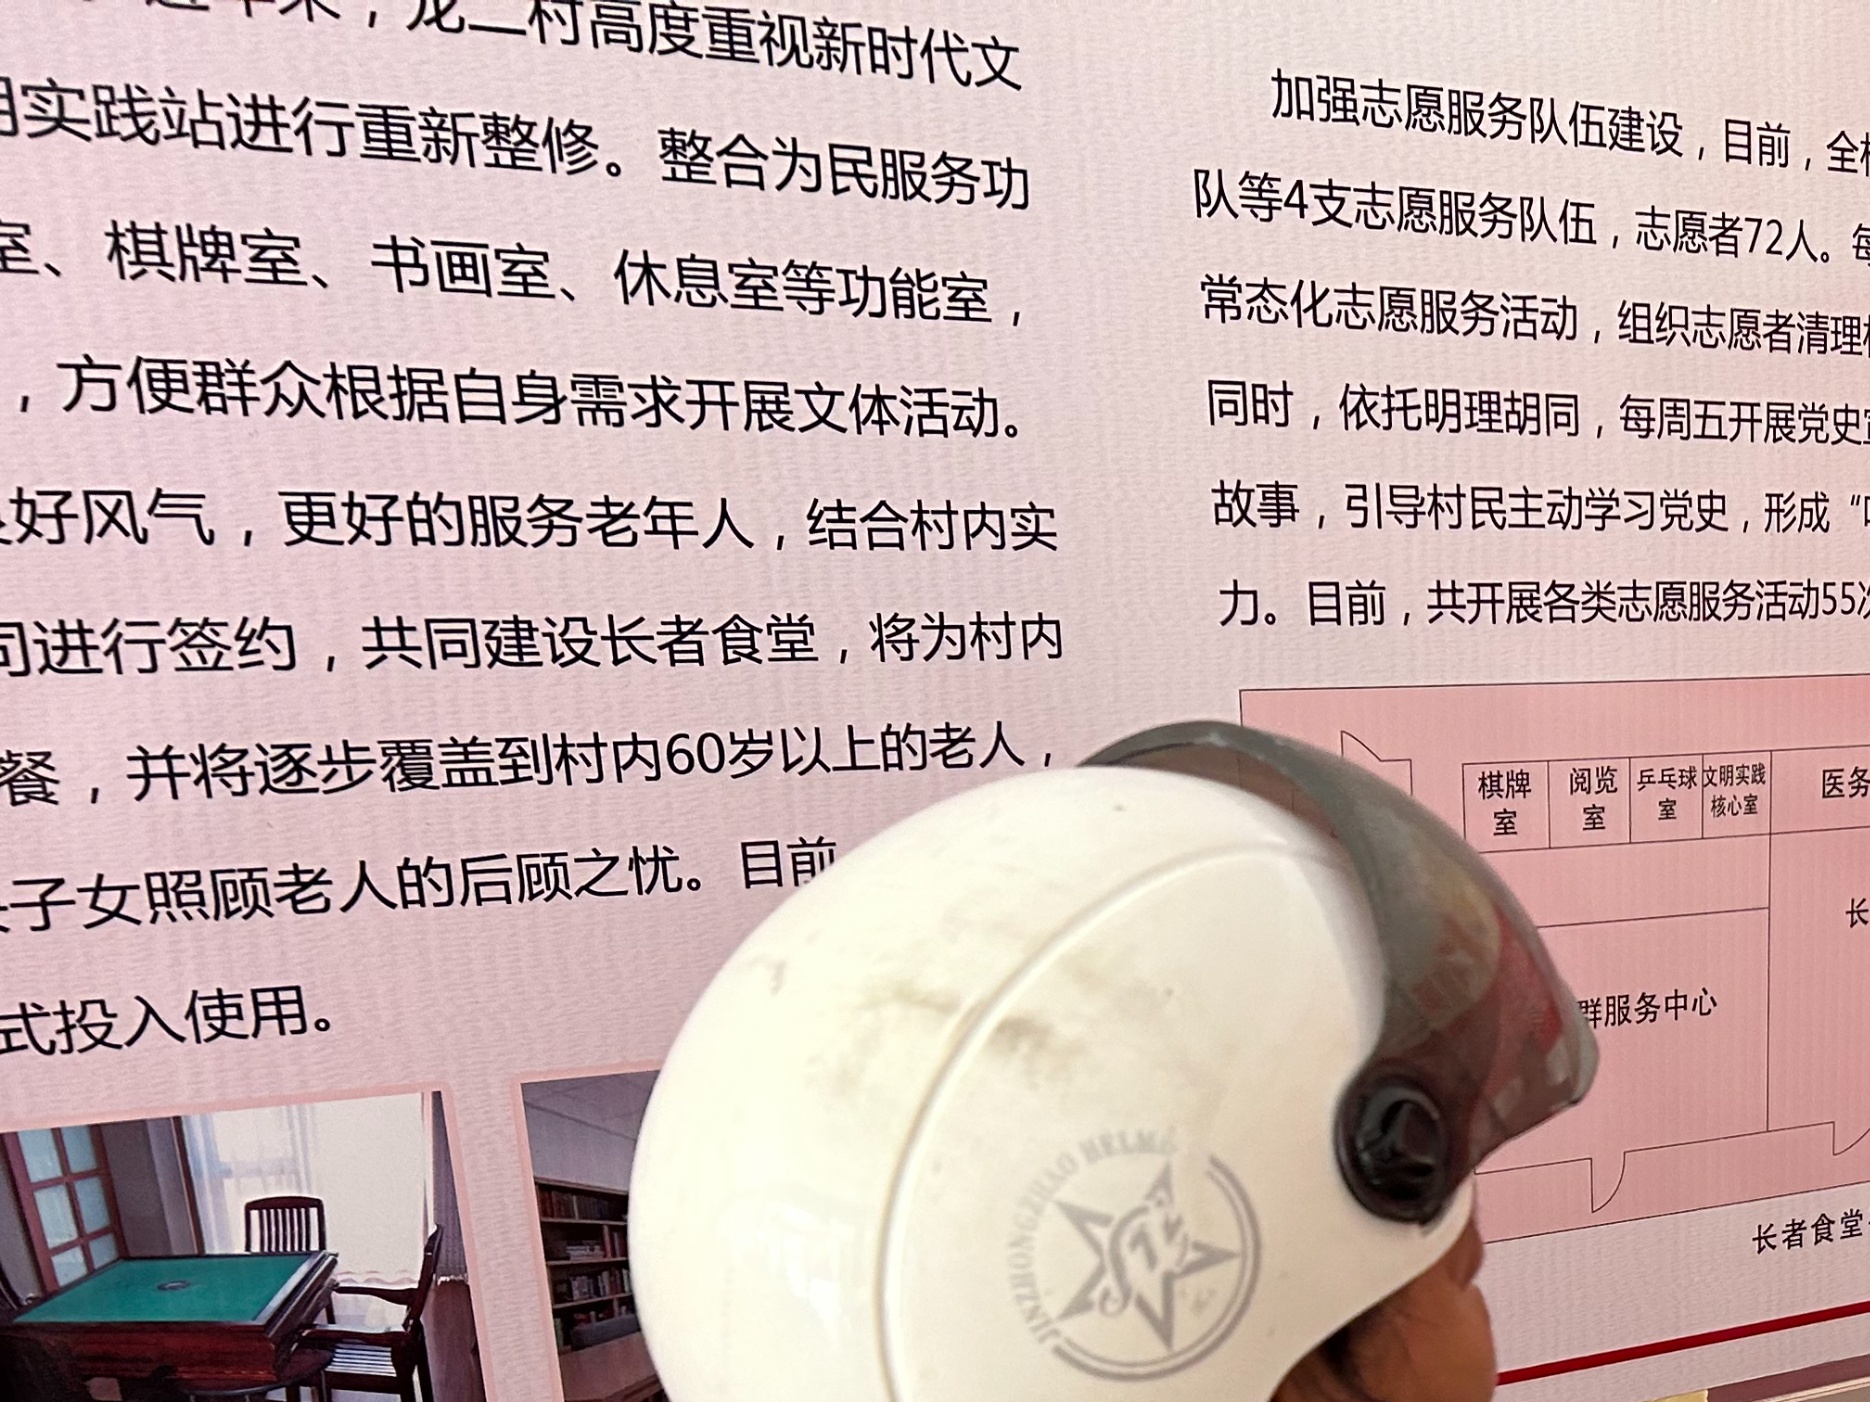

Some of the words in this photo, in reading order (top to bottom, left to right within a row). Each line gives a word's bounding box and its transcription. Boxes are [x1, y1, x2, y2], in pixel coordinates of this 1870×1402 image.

[0, 485, 1059, 553] 好风气，更好的服务老年人，结合村内实
[1477, 768, 1532, 800] 棋牌
[1568, 765, 1619, 796] 阅览
[1637, 765, 1698, 792] 乒乓球
[1701, 762, 1766, 789] 文明实践
[1582, 803, 1606, 831] 室
[1658, 797, 1677, 821] 室
[1710, 793, 1758, 818] 核心室
[1493, 808, 1518, 836] 室
[0, 834, 837, 935] 子女照顾老人的后顾之忧。目前
